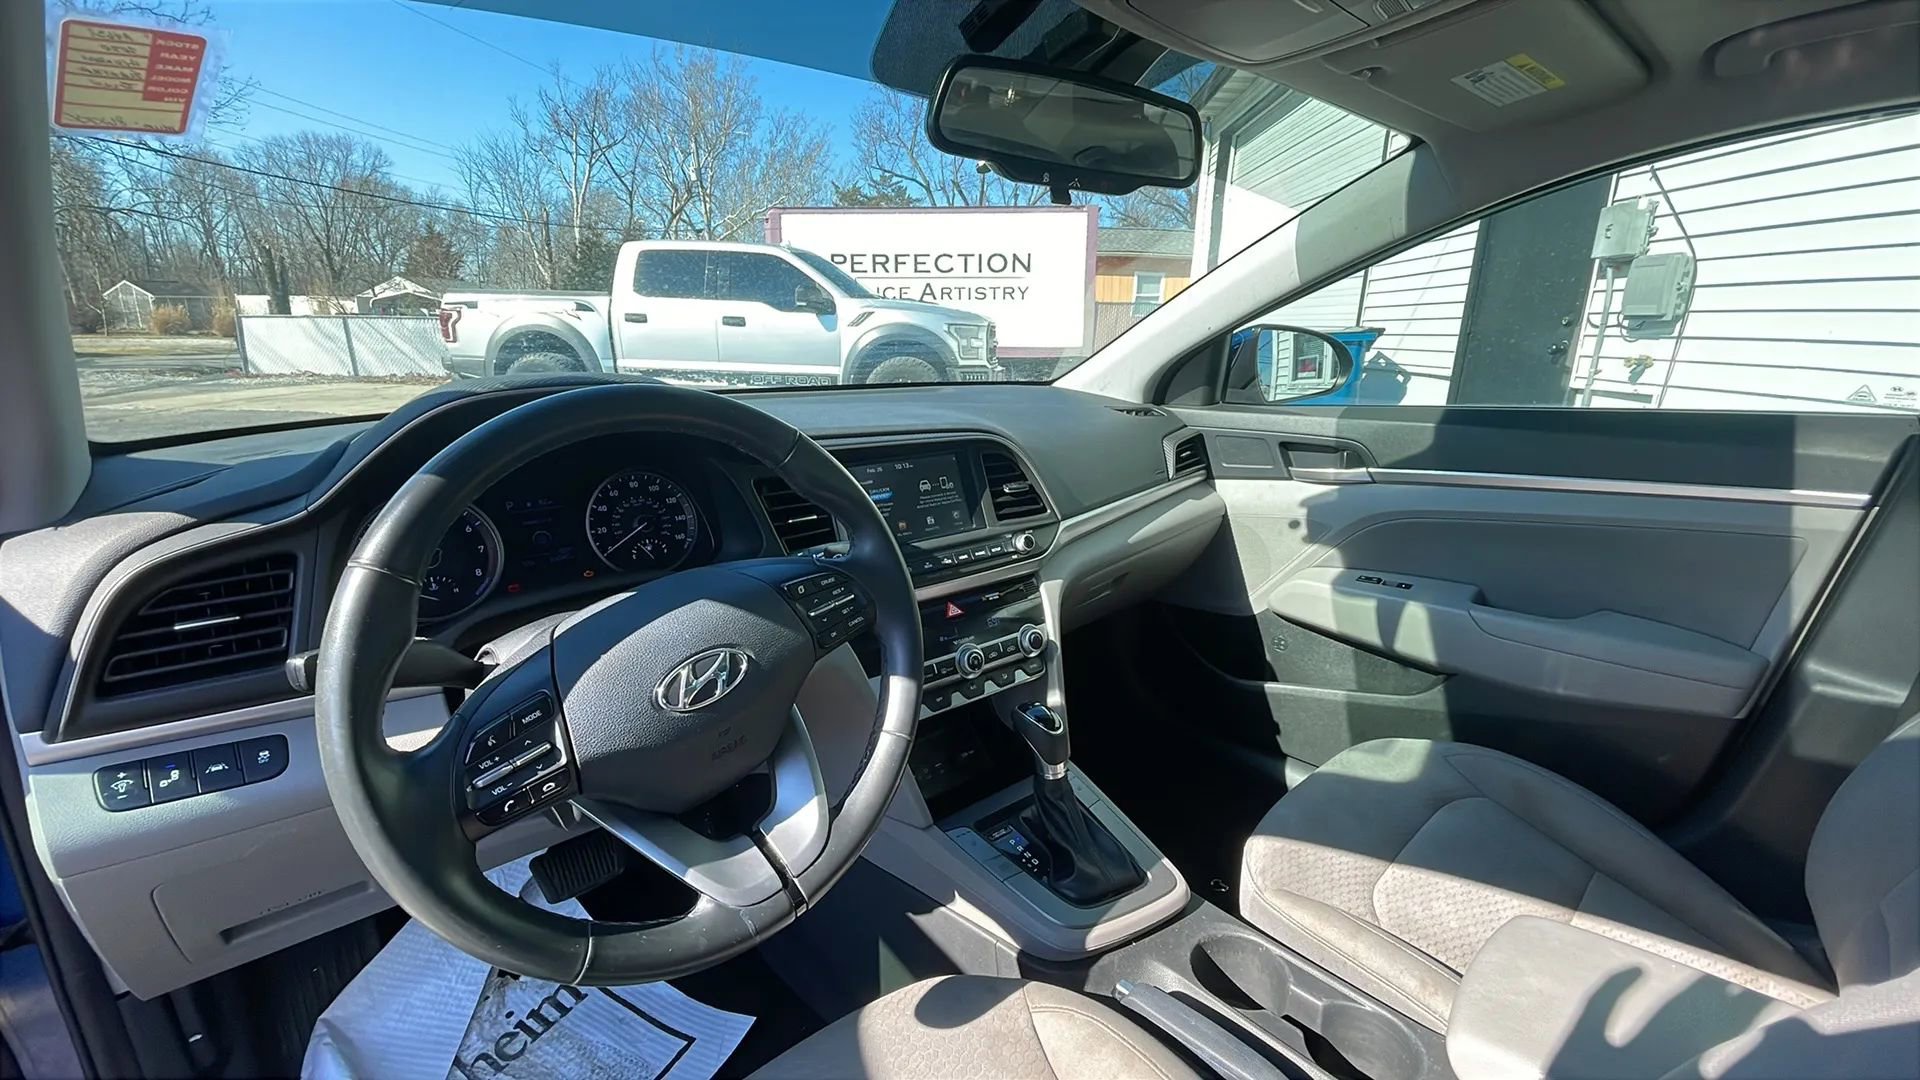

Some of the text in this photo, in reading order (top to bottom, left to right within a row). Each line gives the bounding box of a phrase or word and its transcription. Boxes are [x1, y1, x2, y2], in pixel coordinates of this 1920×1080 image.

[830, 252, 1031, 274] PERFECTION
[919, 282, 1029, 301] ARTISTRY
[750, 374, 832, 387] OFF ROAD
[648, 484, 660, 492] 100
[609, 489, 619, 497] 60
[465, 525, 473, 534] 6
[597, 526, 607, 534] 20
[477, 545, 484, 553] 7
[475, 568, 483, 577] 8
[521, 709, 543, 725] MODE
[478, 759, 494, 770] VOL
[491, 785, 506, 796] VOL
[1031, 858, 1039, 866] D
